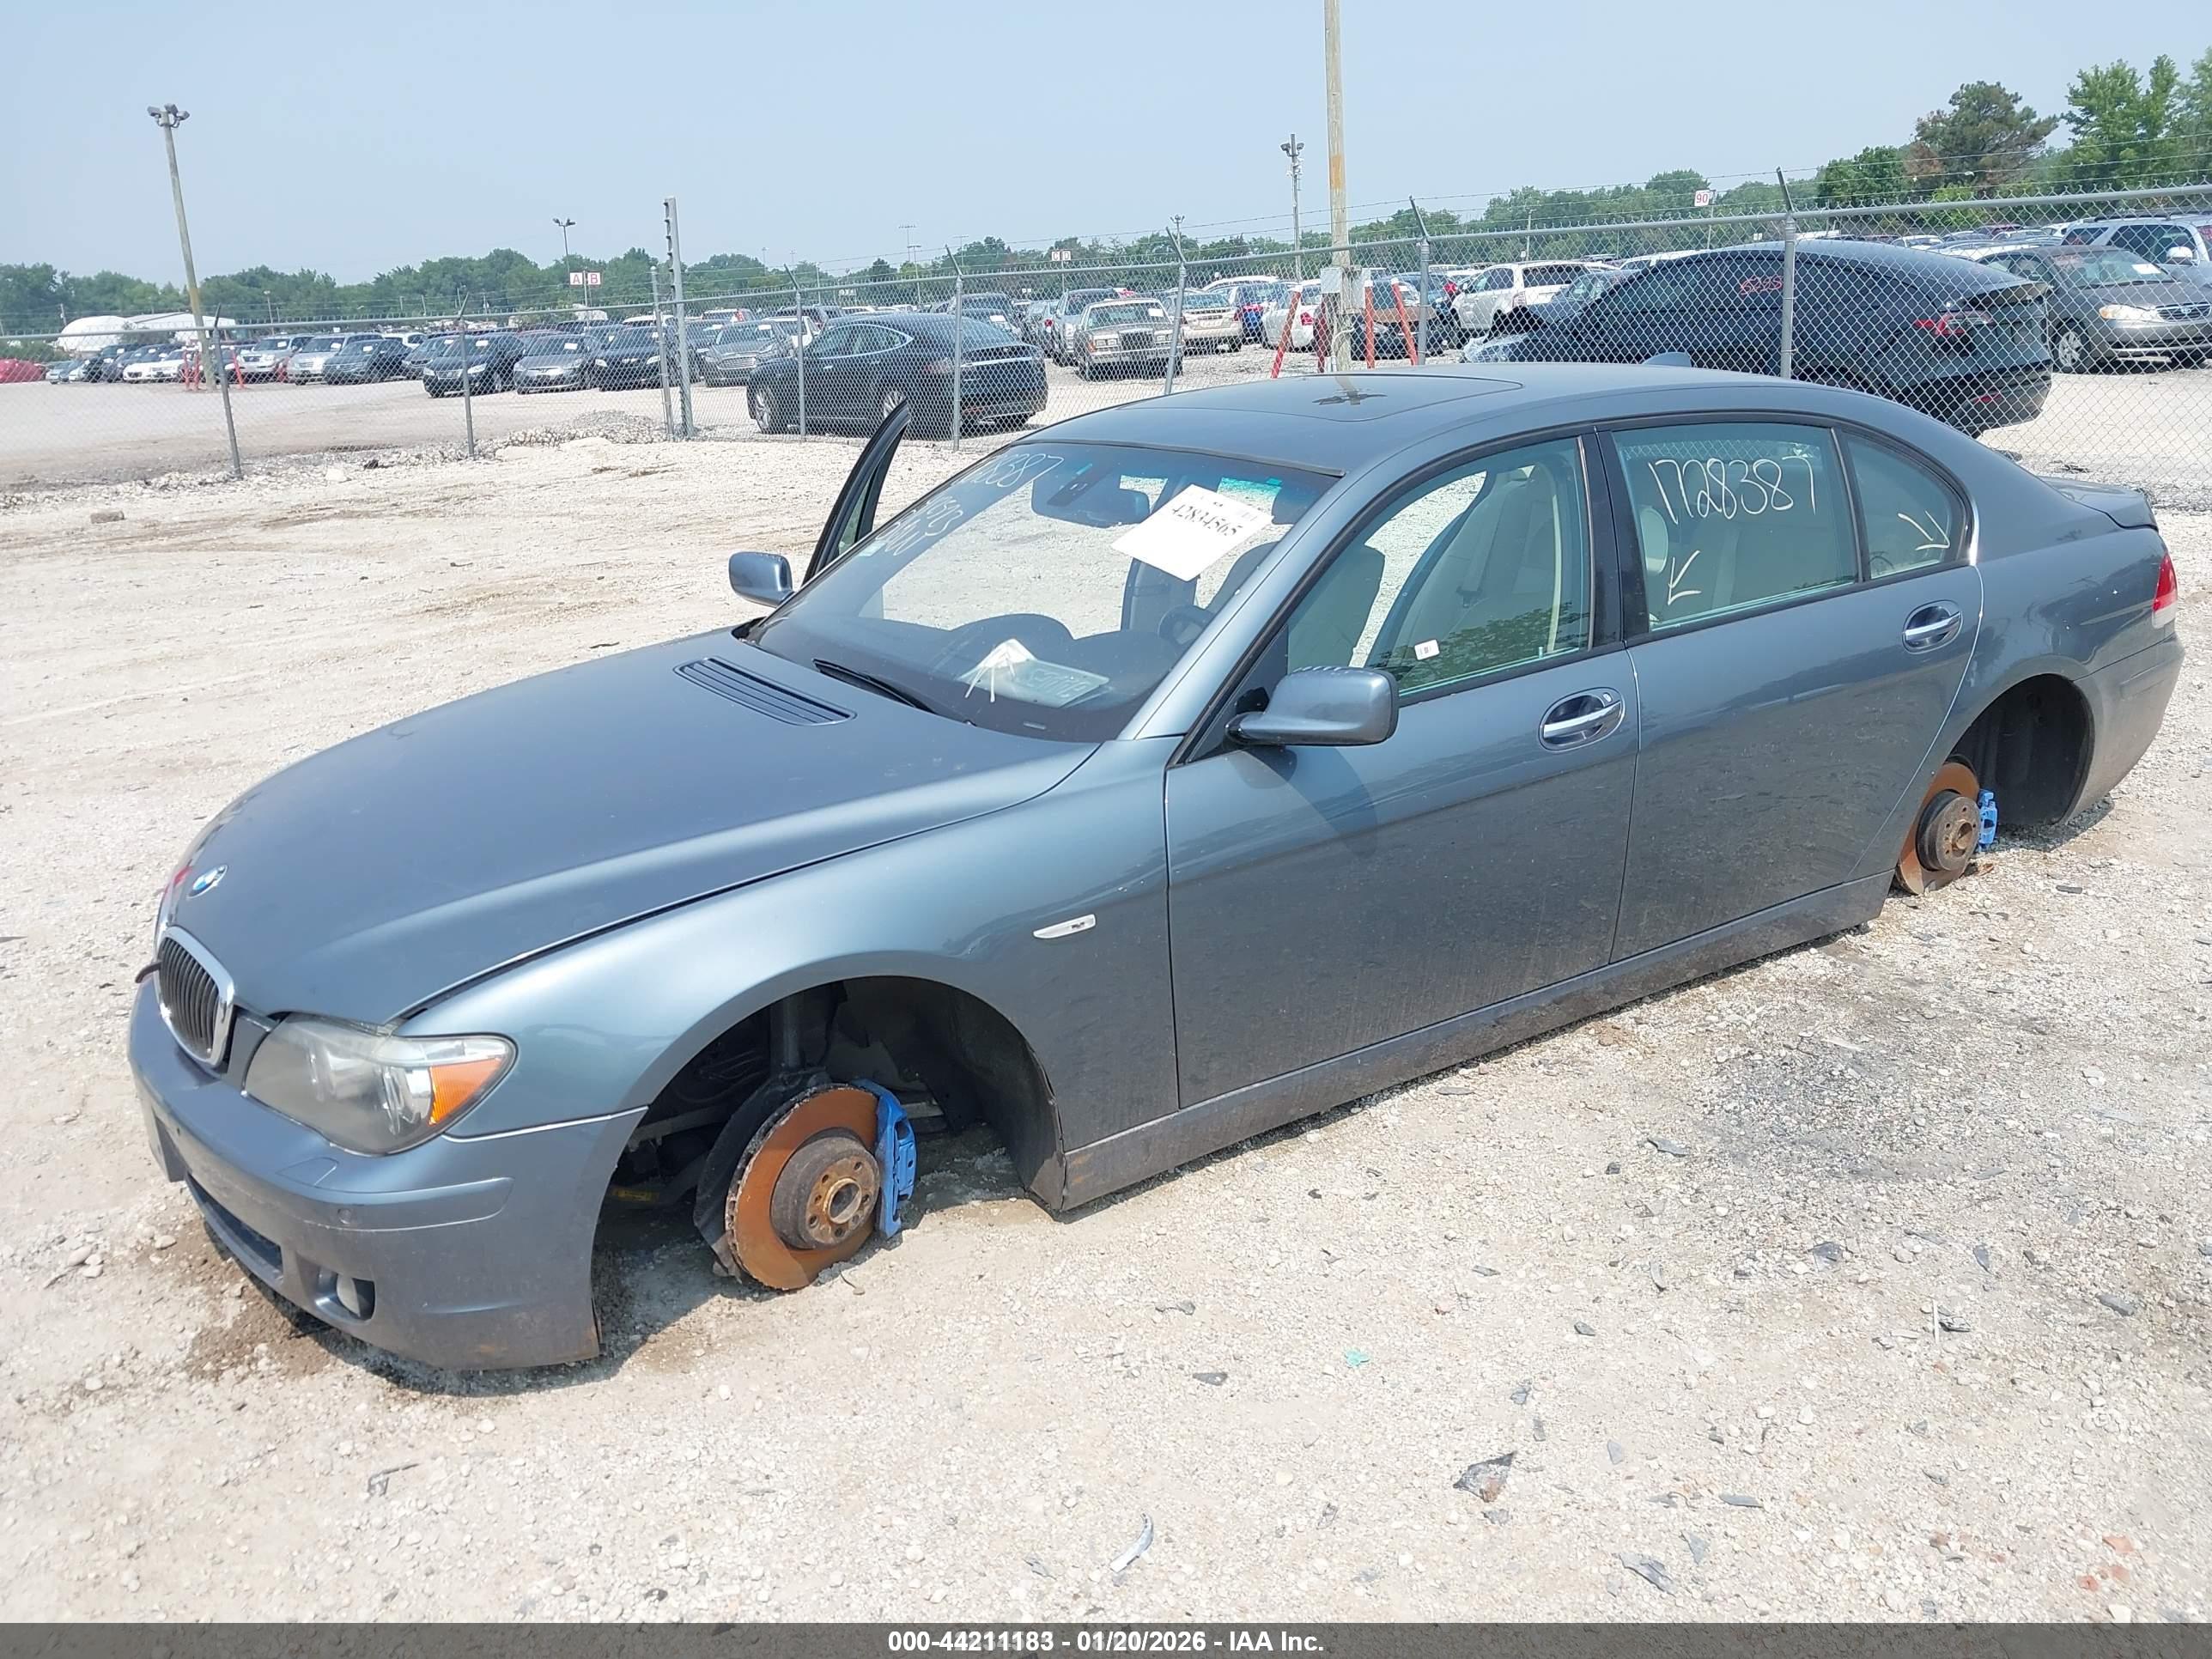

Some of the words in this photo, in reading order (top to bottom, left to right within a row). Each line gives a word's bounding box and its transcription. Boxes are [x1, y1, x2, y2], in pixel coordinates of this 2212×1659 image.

[1696, 193, 1709, 204] 90
[572, 274, 581, 284] A
[590, 273, 599, 284] B
[1647, 457, 1816, 525] 1728387
[1171, 503, 1244, 537] 42834565
